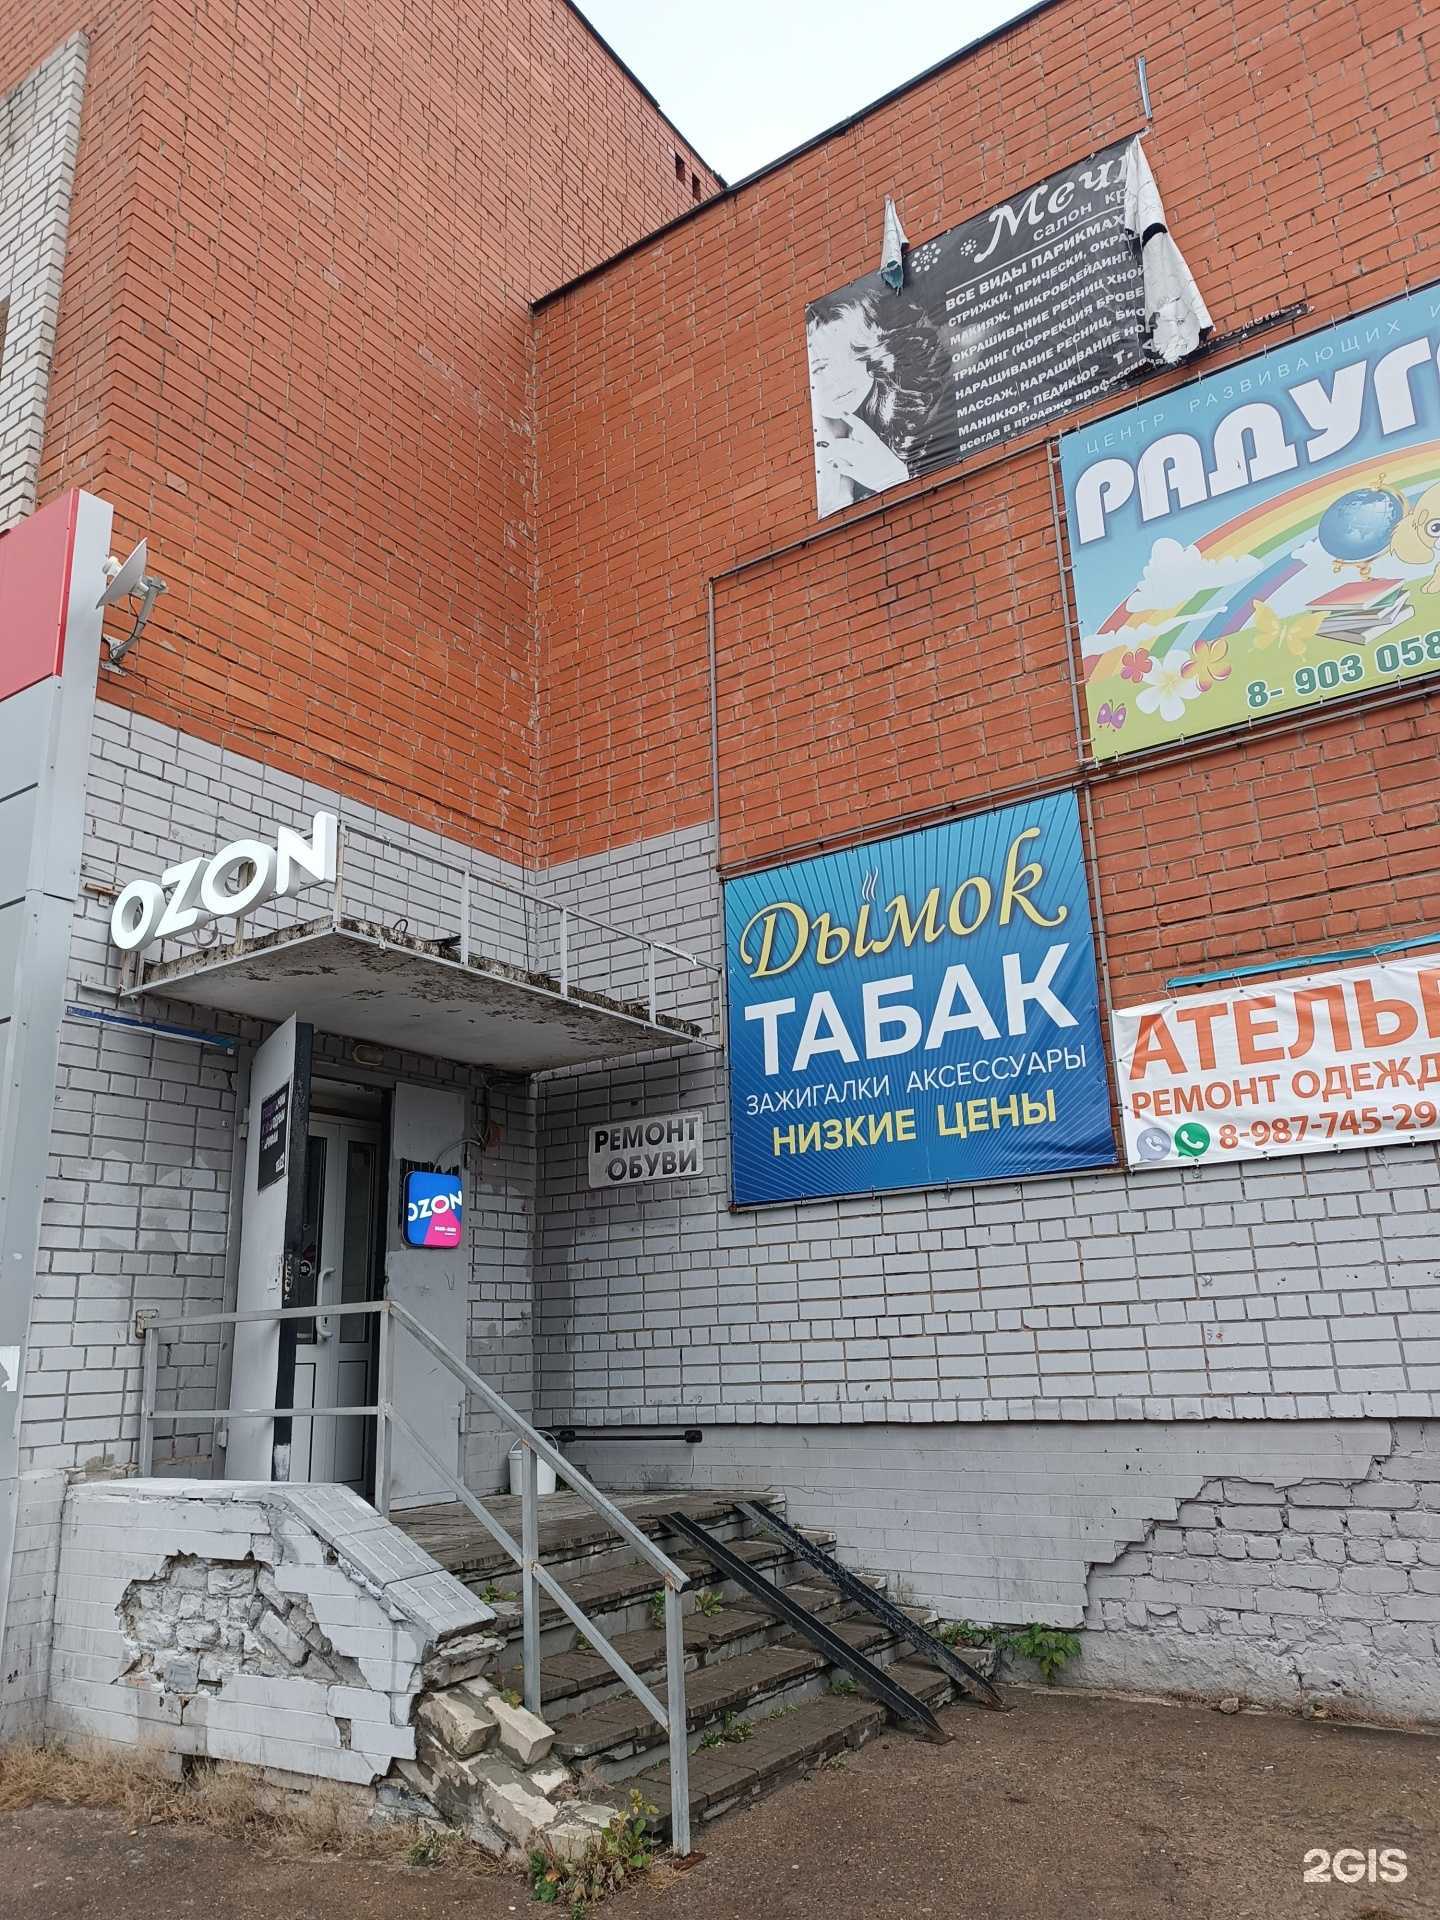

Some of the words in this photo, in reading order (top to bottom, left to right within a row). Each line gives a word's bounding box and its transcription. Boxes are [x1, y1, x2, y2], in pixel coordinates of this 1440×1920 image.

[1033, 202, 1093, 241] салон
[945, 288, 976, 311] ВСЕ
[979, 262, 1027, 295] ВИДЫ
[948, 291, 1012, 327] СТРИЖКИ,
[1015, 251, 1087, 295] ПРИЧЕСКИ,
[950, 310, 1011, 345] МАКИЯЖ,
[952, 311, 1050, 362] ОКРАШИВАНИЕ
[1052, 279, 1104, 315] РЕСНИЦ
[953, 349, 1010, 381] ТРИДИНГ
[1012, 305, 1093, 356] (КОРРЕКЦИЯ
[955, 348, 1054, 400] НАРАЩИВАНИЕ
[957, 386, 1017, 418] МАССАЖ,
[1020, 331, 1120, 391] НАРАЩИВАНИЕ
[958, 401, 1030, 437] МАНИКЮР,
[1033, 365, 1099, 405] ПЕДИКЮР
[1086, 412, 1165, 454] ЦЕНТР
[1188, 319, 1401, 412] РАЗВИВАЮЩИХ
[960, 429, 1000, 451] всегда
[1003, 424, 1011, 433] в
[1014, 399, 1072, 427] продаже
[1075, 336, 1440, 545] РАДУГ
[1247, 679, 1284, 708] 8-
[1296, 655, 1364, 695] 903
[111, 811, 338, 951] OZON
[739, 827, 1068, 979] Дымок
[744, 943, 1080, 1076] ТАБАК
[745, 1074, 890, 1116] ЗАЖИГАЛКИ
[906, 1045, 1087, 1093] АКСЕССУАРЫ
[1131, 1074, 1281, 1118] РЕМОНТ
[595, 1117, 698, 1153] РЕМОНТ
[773, 1108, 916, 1156] НИЗКИЕ
[937, 1089, 1056, 1139] ЦЕНЫ
[1218, 1101, 1438, 1150] 8-987-745-29
[608, 1148, 697, 1181] ОБУВИ
[408, 1190, 463, 1222] OZON
